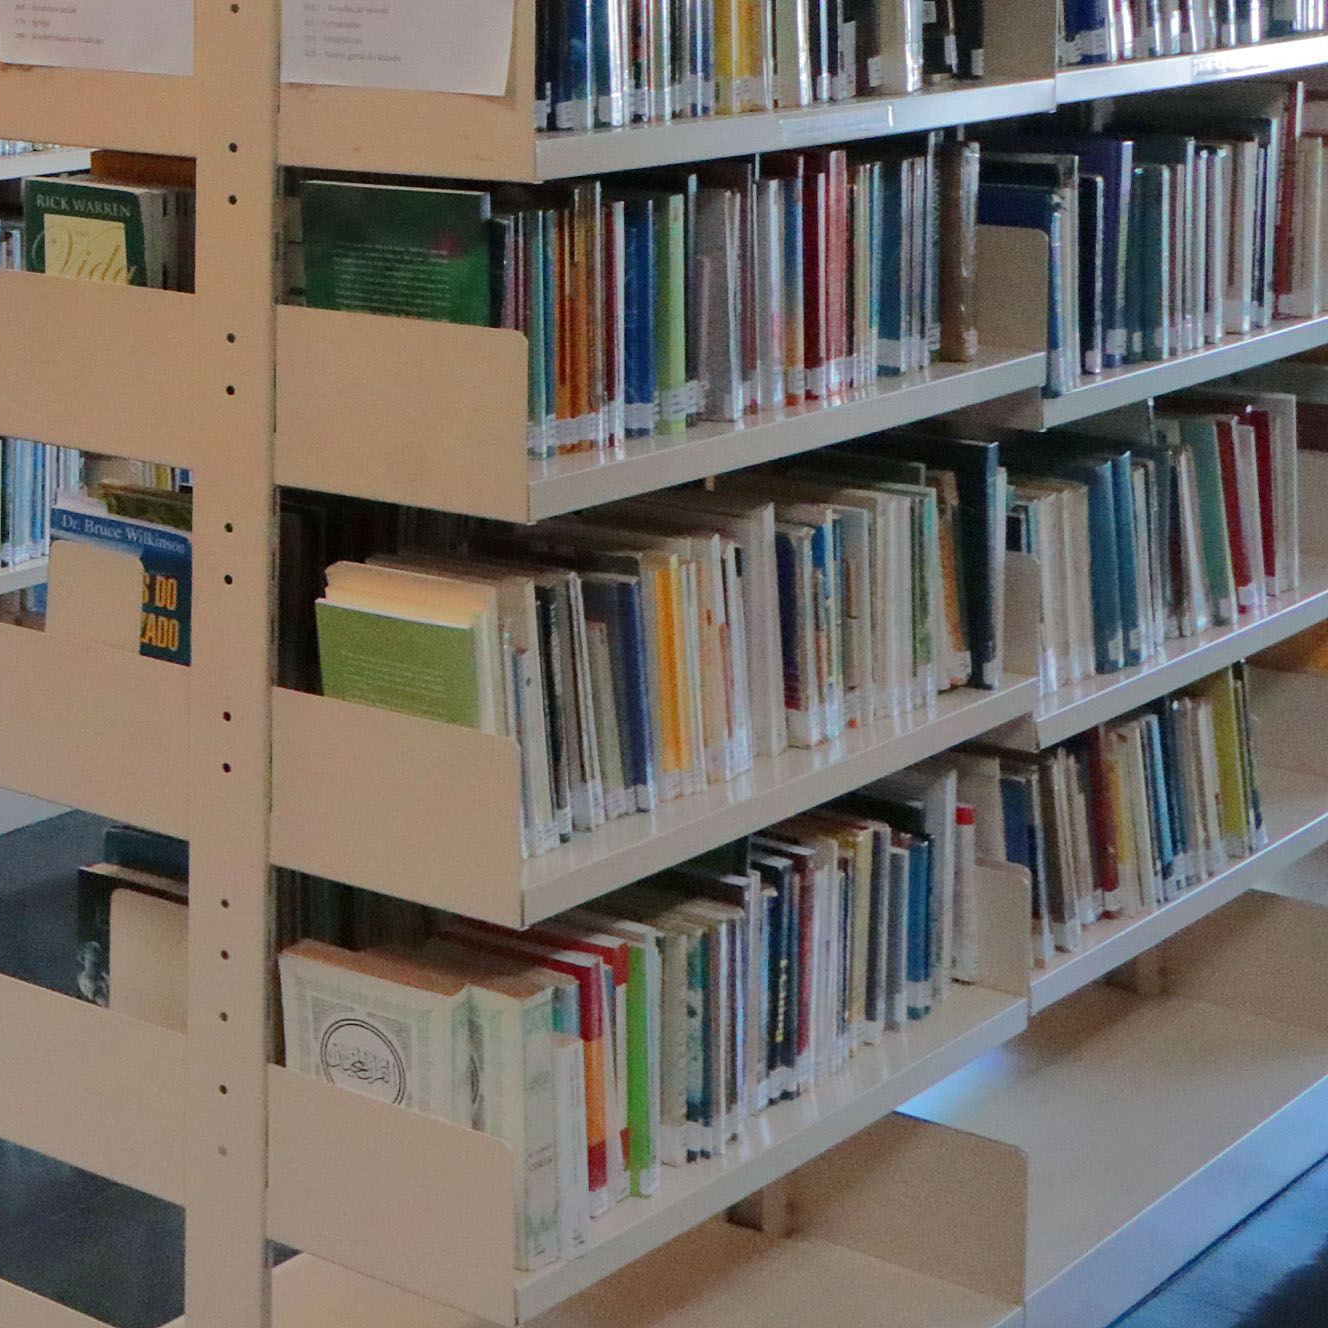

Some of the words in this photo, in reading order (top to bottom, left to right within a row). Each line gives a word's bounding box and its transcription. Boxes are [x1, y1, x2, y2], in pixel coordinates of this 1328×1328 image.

[36, 194, 69, 211] RICK
[72, 197, 131, 217] WARREN
[62, 514, 81, 531] Dr.
[84, 519, 122, 539] Bruce
[126, 527, 186, 554] Wilkinson
[154, 575, 179, 611] DO
